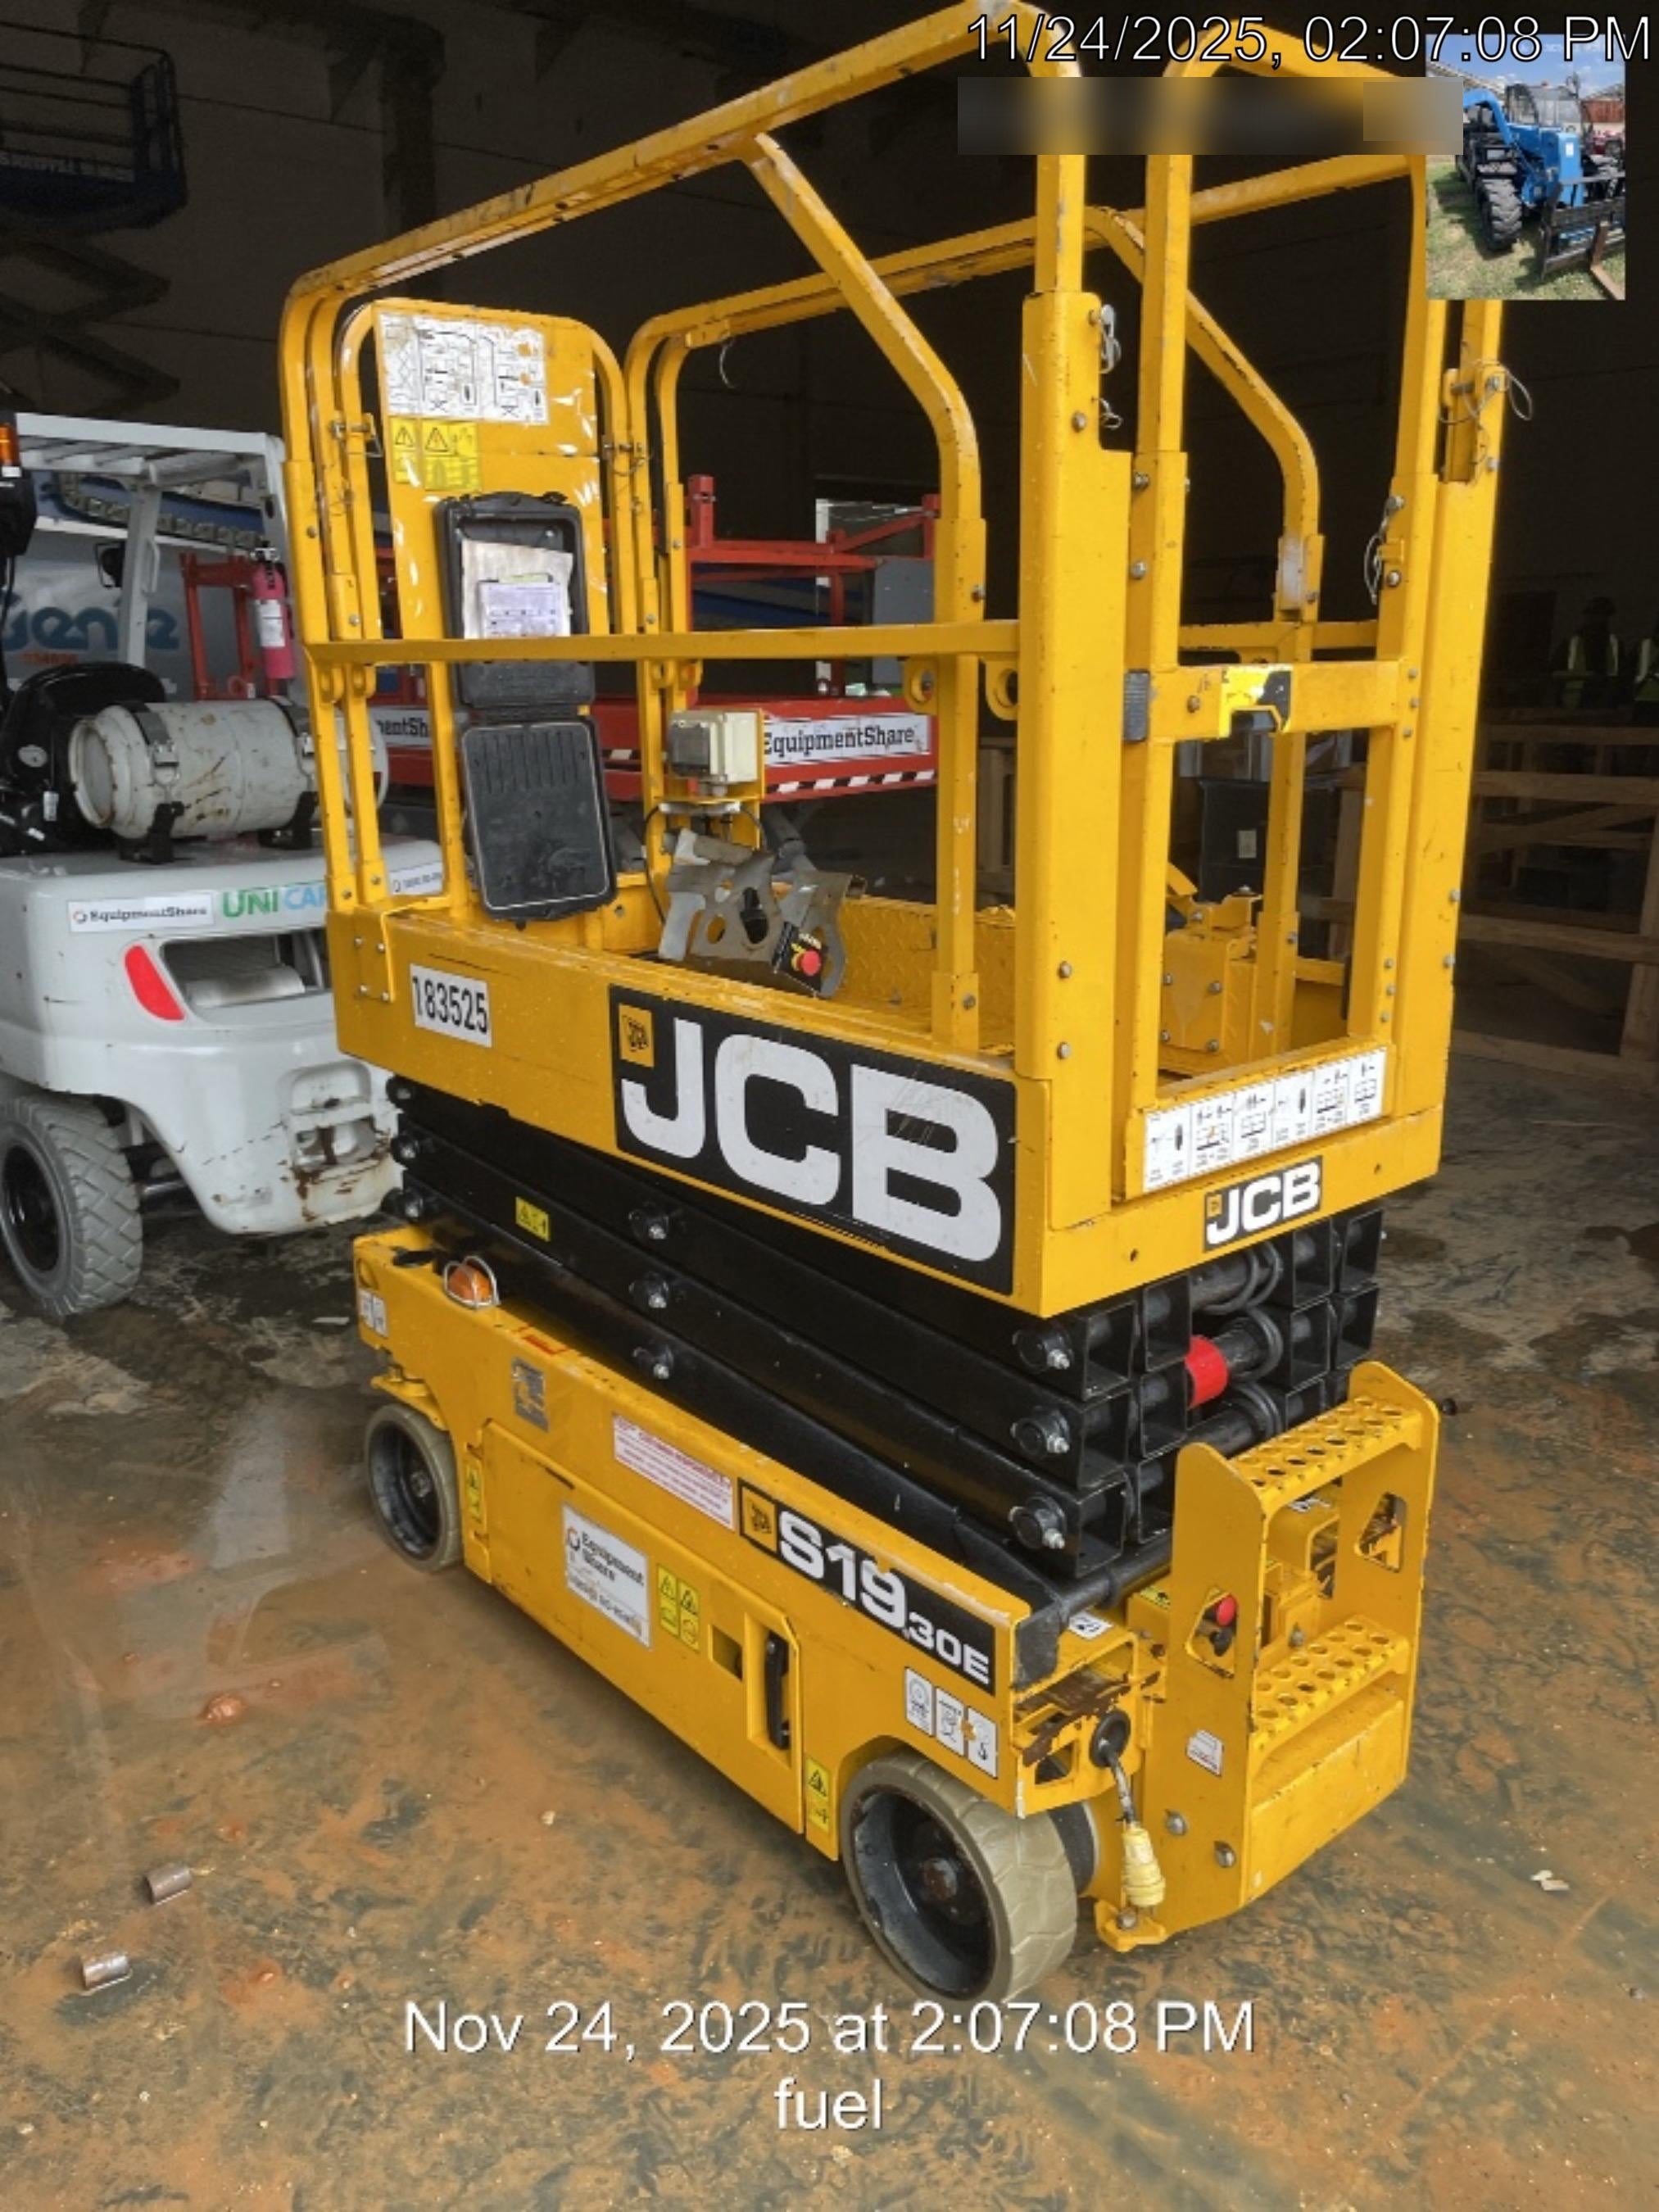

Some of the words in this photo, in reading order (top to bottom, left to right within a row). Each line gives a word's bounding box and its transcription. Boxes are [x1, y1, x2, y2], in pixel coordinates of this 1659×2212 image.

[412, 976, 487, 1034] 183525
[620, 1017, 1002, 1262] JCB
[1206, 1161, 1321, 1245] JCB
